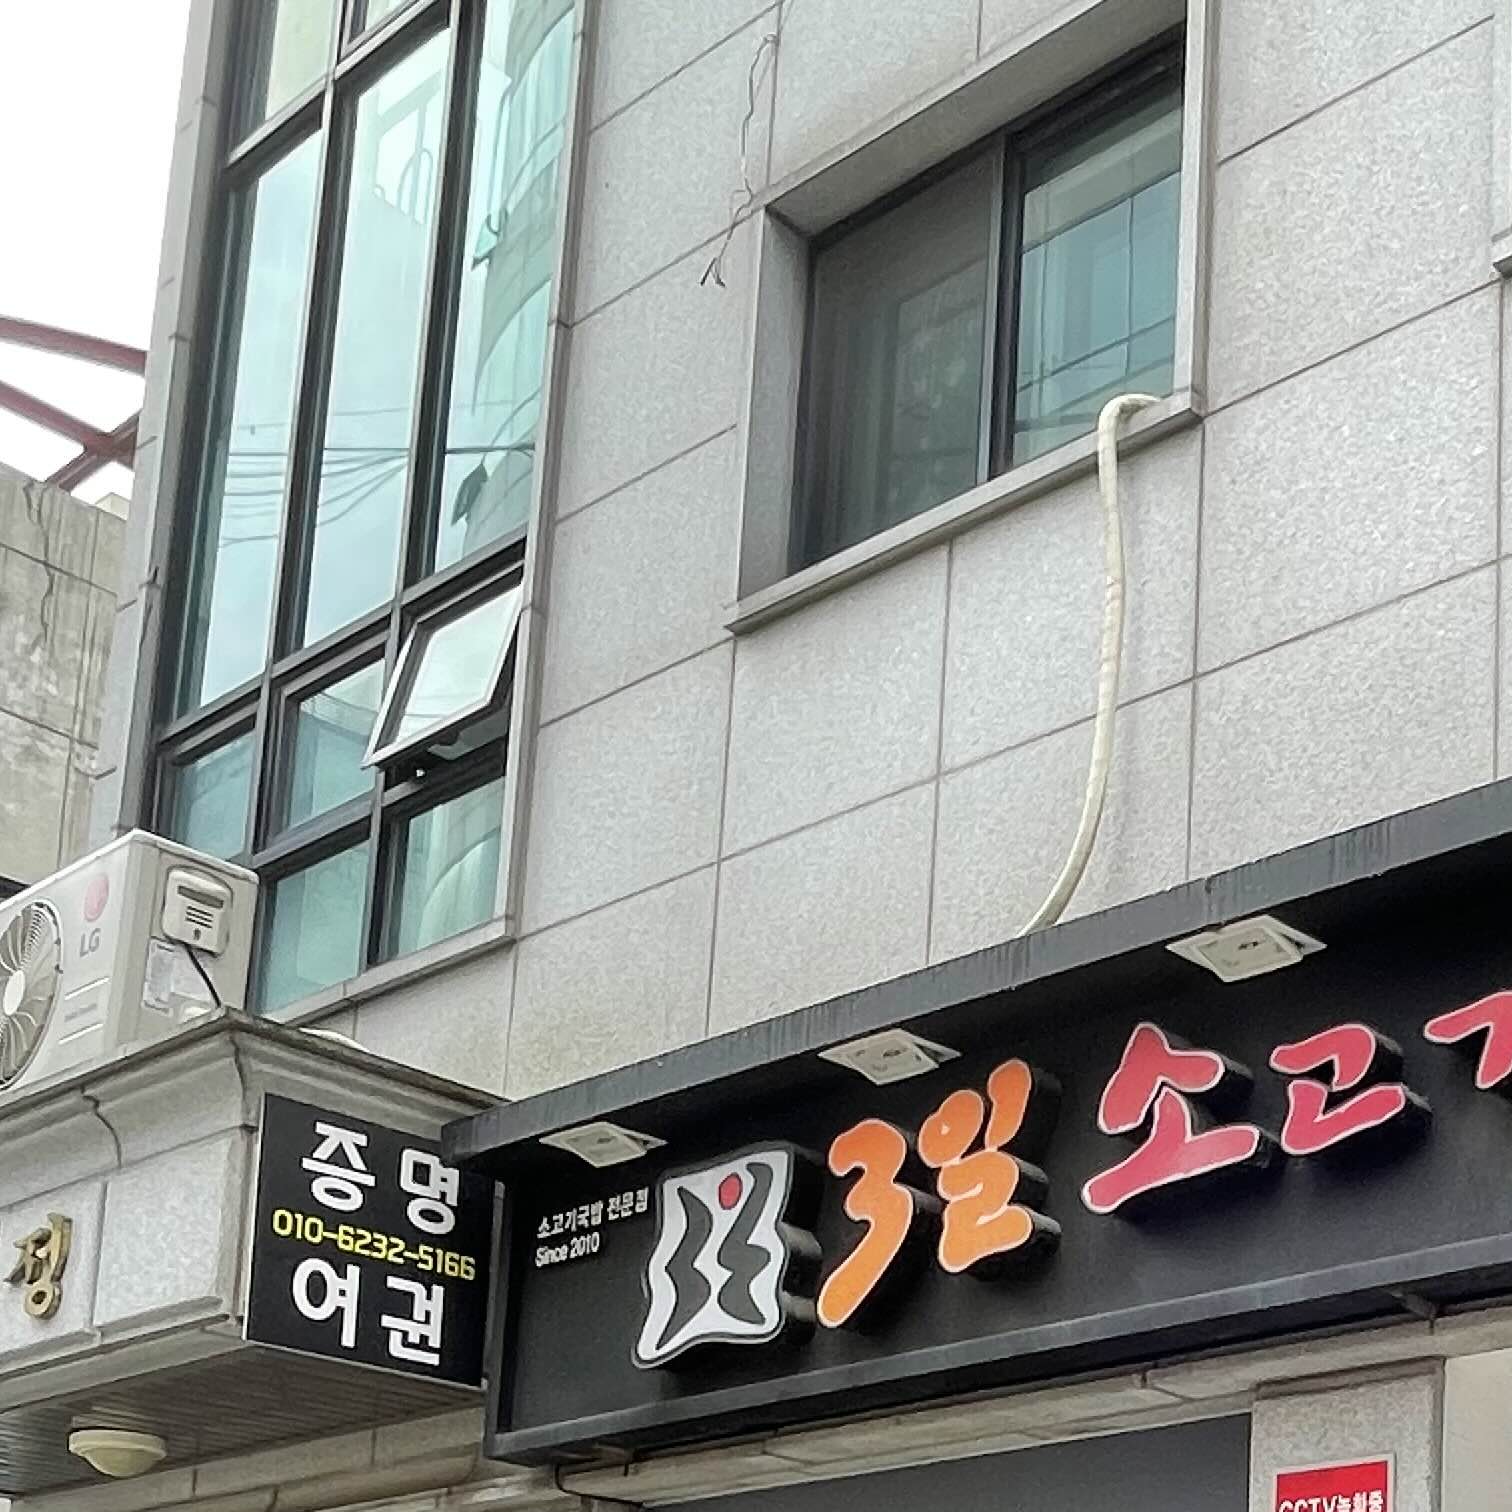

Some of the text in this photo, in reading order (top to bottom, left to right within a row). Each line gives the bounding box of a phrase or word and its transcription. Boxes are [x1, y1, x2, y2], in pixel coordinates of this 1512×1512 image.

[80, 927, 101, 957] LG
[816, 1057, 1033, 1328] 3일
[537, 1200, 604, 1239] 소고기국밥
[272, 1209, 476, 1281] 010-6232-5166
[535, 1231, 600, 1267] Since 2010
